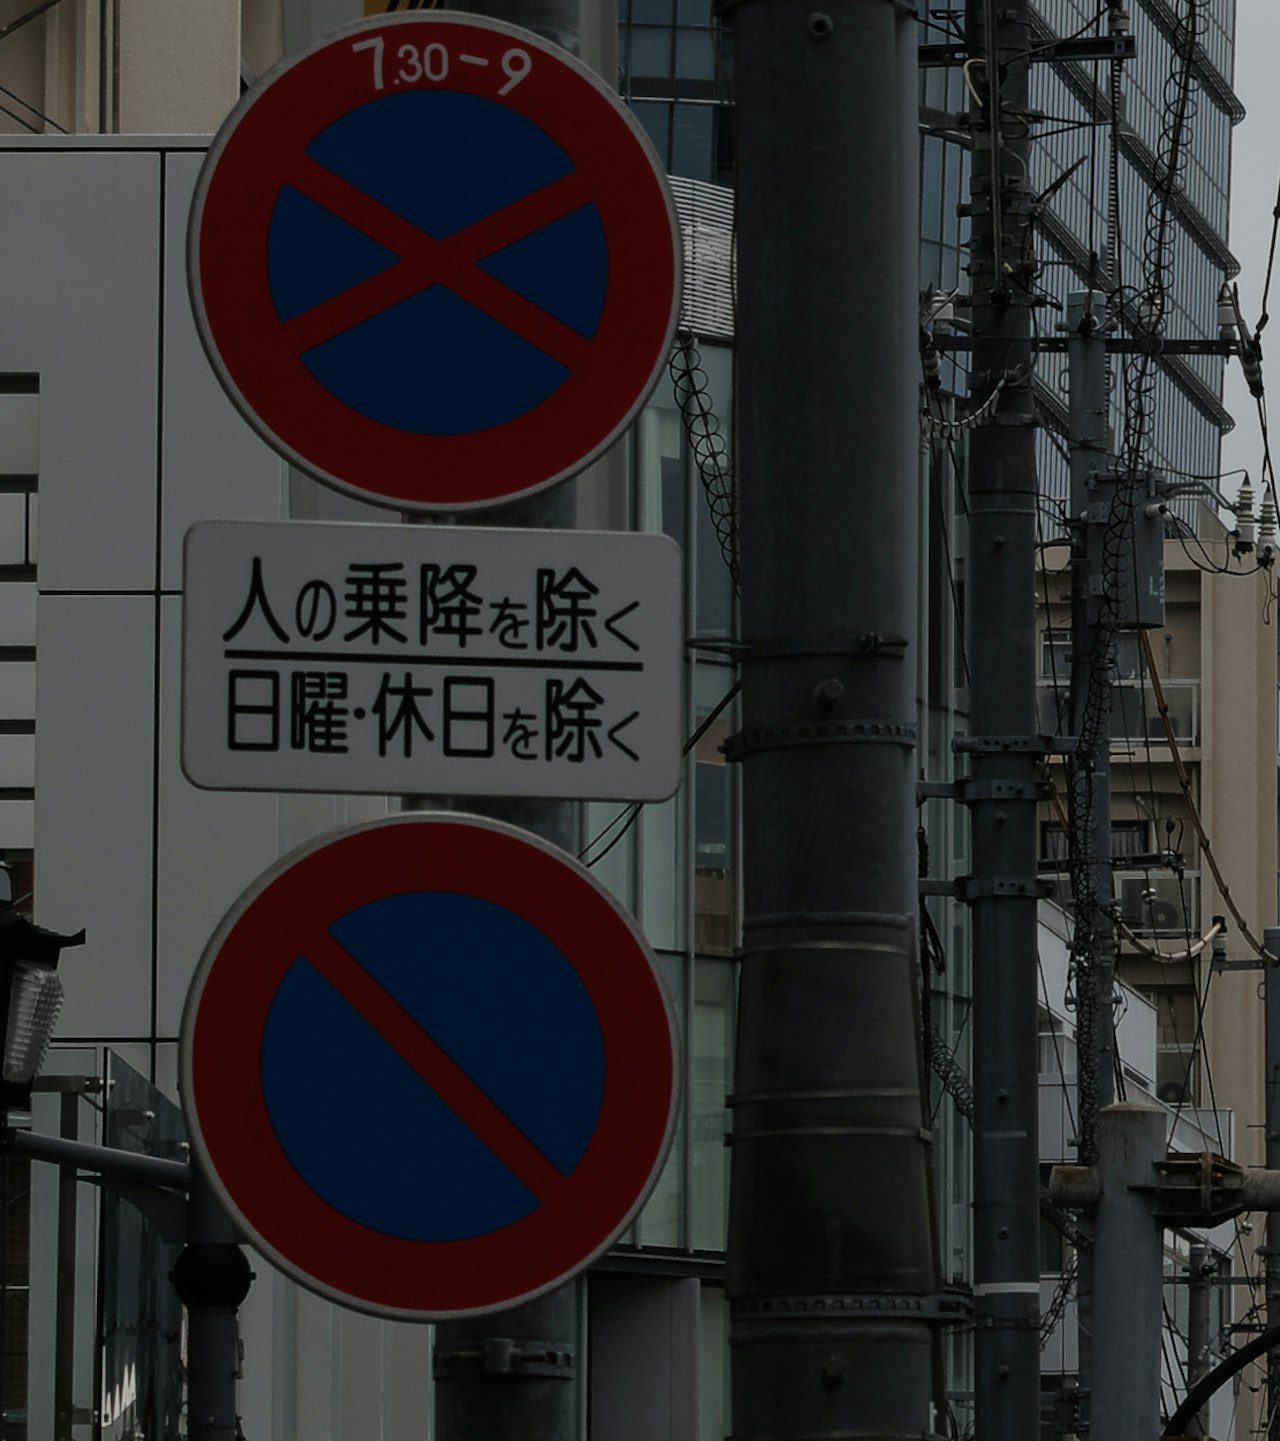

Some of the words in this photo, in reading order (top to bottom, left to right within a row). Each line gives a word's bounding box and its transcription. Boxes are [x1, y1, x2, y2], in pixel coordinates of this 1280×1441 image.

[223, 557, 641, 653] 人の乗降を除く
[227, 669, 640, 764] 日曜・休日を除く
